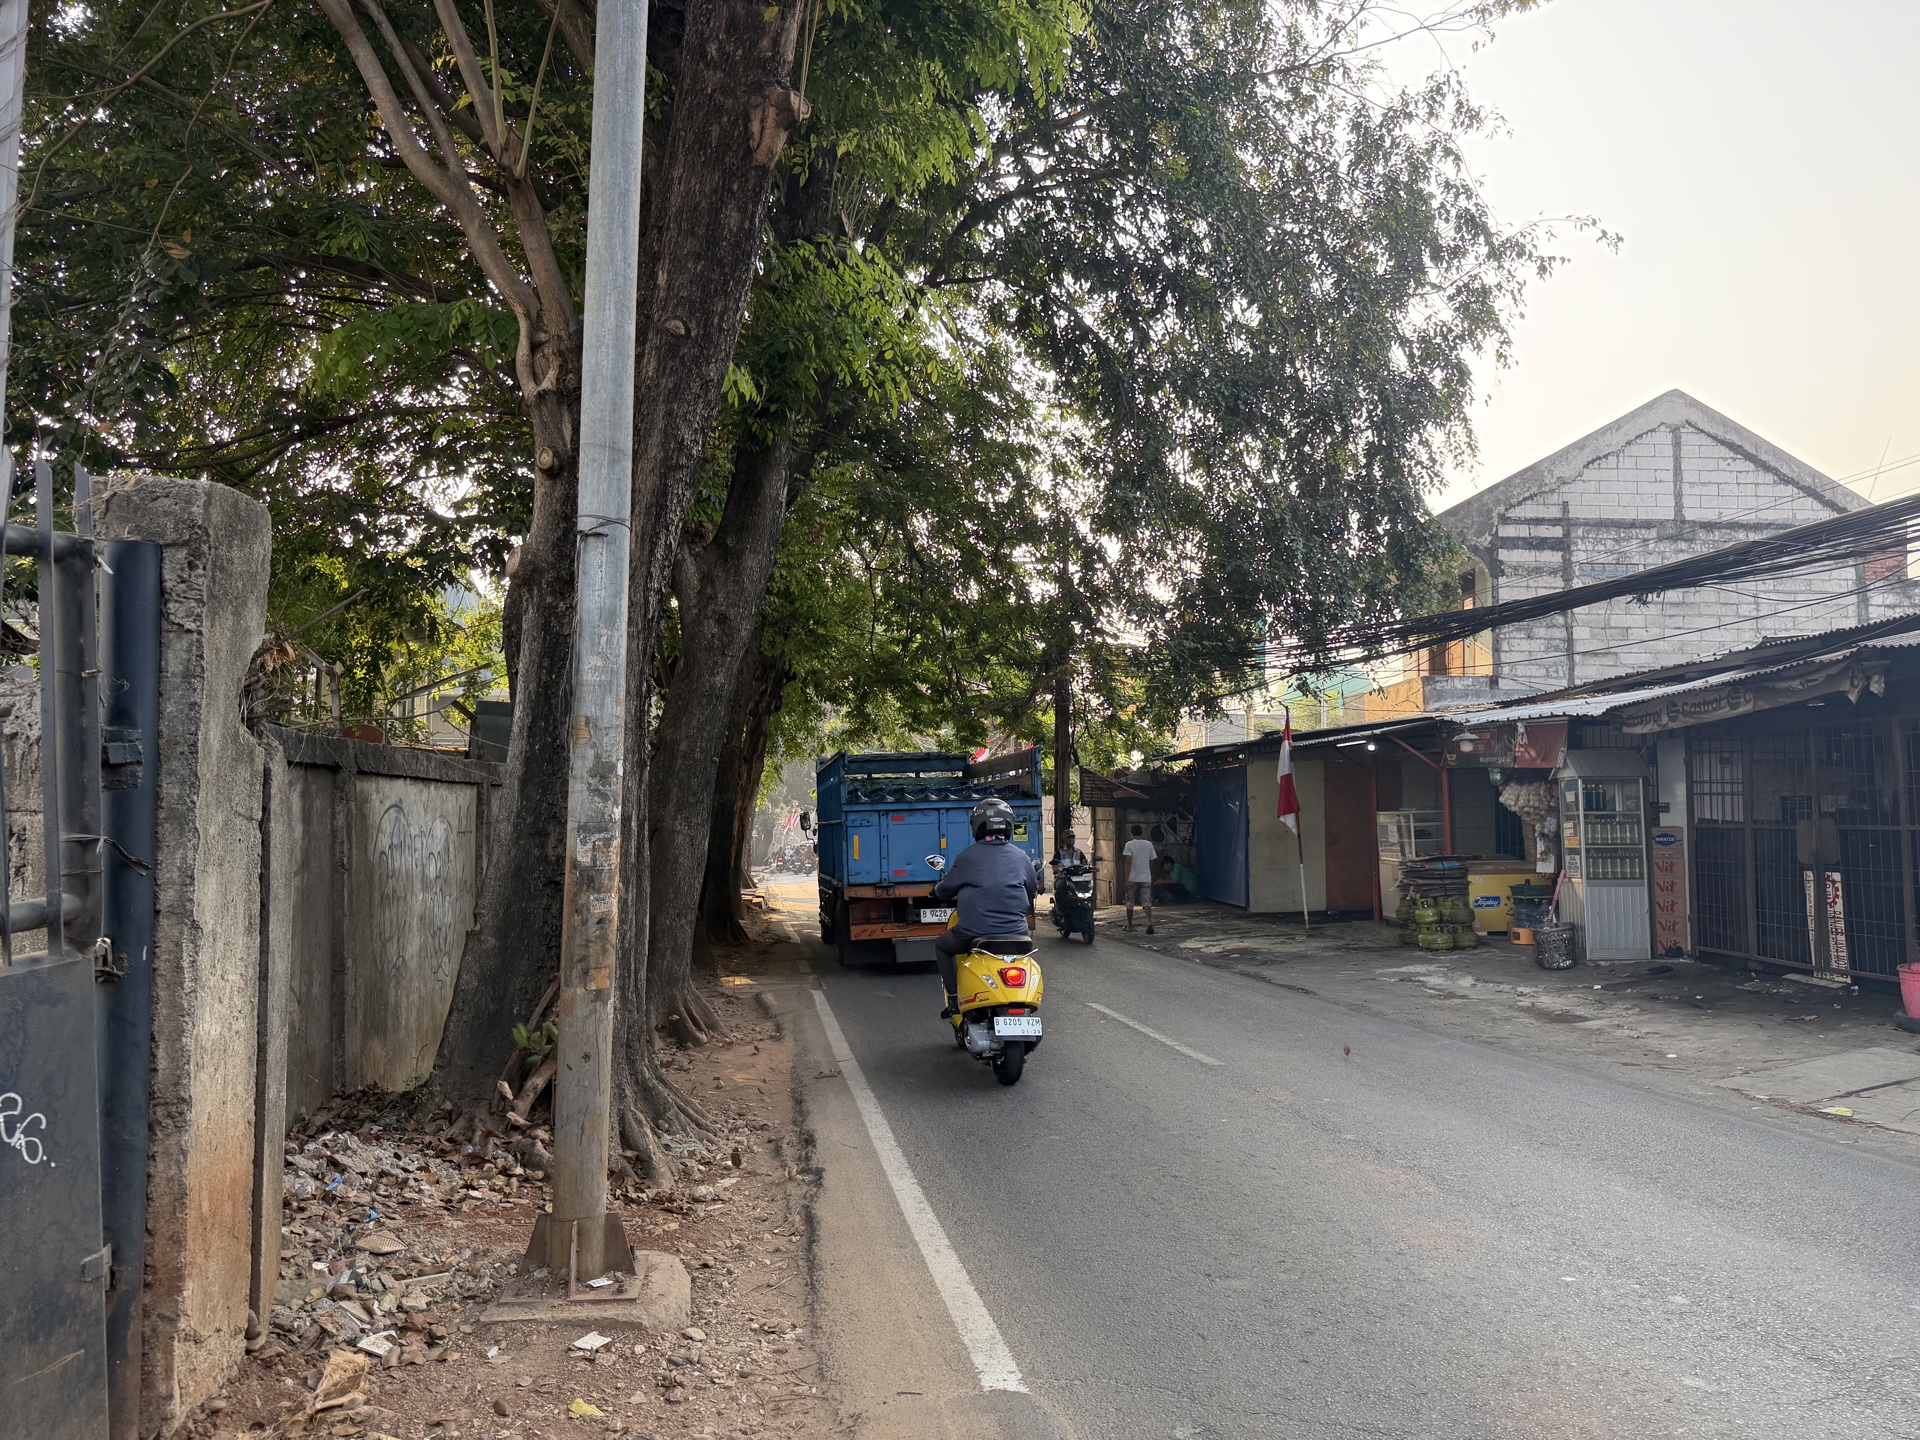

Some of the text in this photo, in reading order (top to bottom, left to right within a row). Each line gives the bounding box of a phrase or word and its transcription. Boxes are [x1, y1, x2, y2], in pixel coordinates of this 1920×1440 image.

[1681, 693, 1722, 716] Castrol
[1654, 860, 1678, 874] Vit
[1655, 879, 1679, 893] Vit
[1474, 897, 1499, 908] Joyday
[1655, 899, 1679, 914] Vit
[922, 909, 928, 918] B
[1657, 919, 1680, 933] Vit
[995, 1018, 1041, 1027] B 6205 VZM
